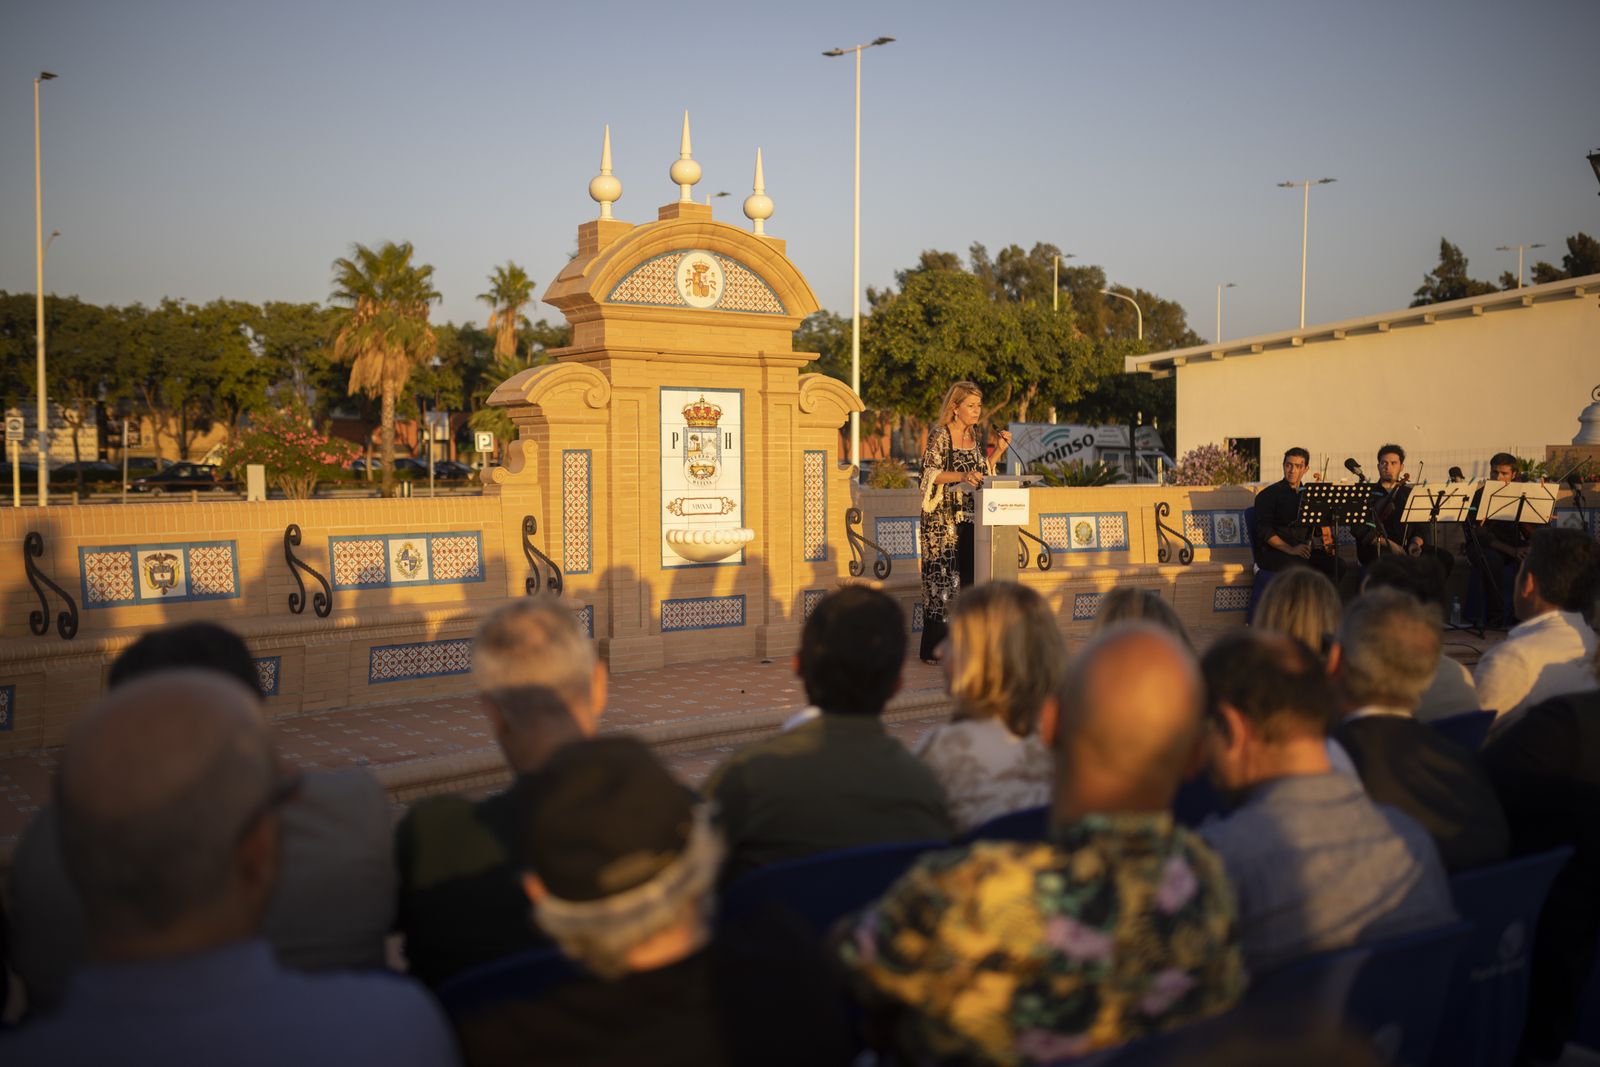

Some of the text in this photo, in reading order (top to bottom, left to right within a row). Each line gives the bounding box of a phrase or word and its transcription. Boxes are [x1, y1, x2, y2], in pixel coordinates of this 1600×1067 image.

[479, 434, 490, 450] P
[672, 432, 732, 449] P H
